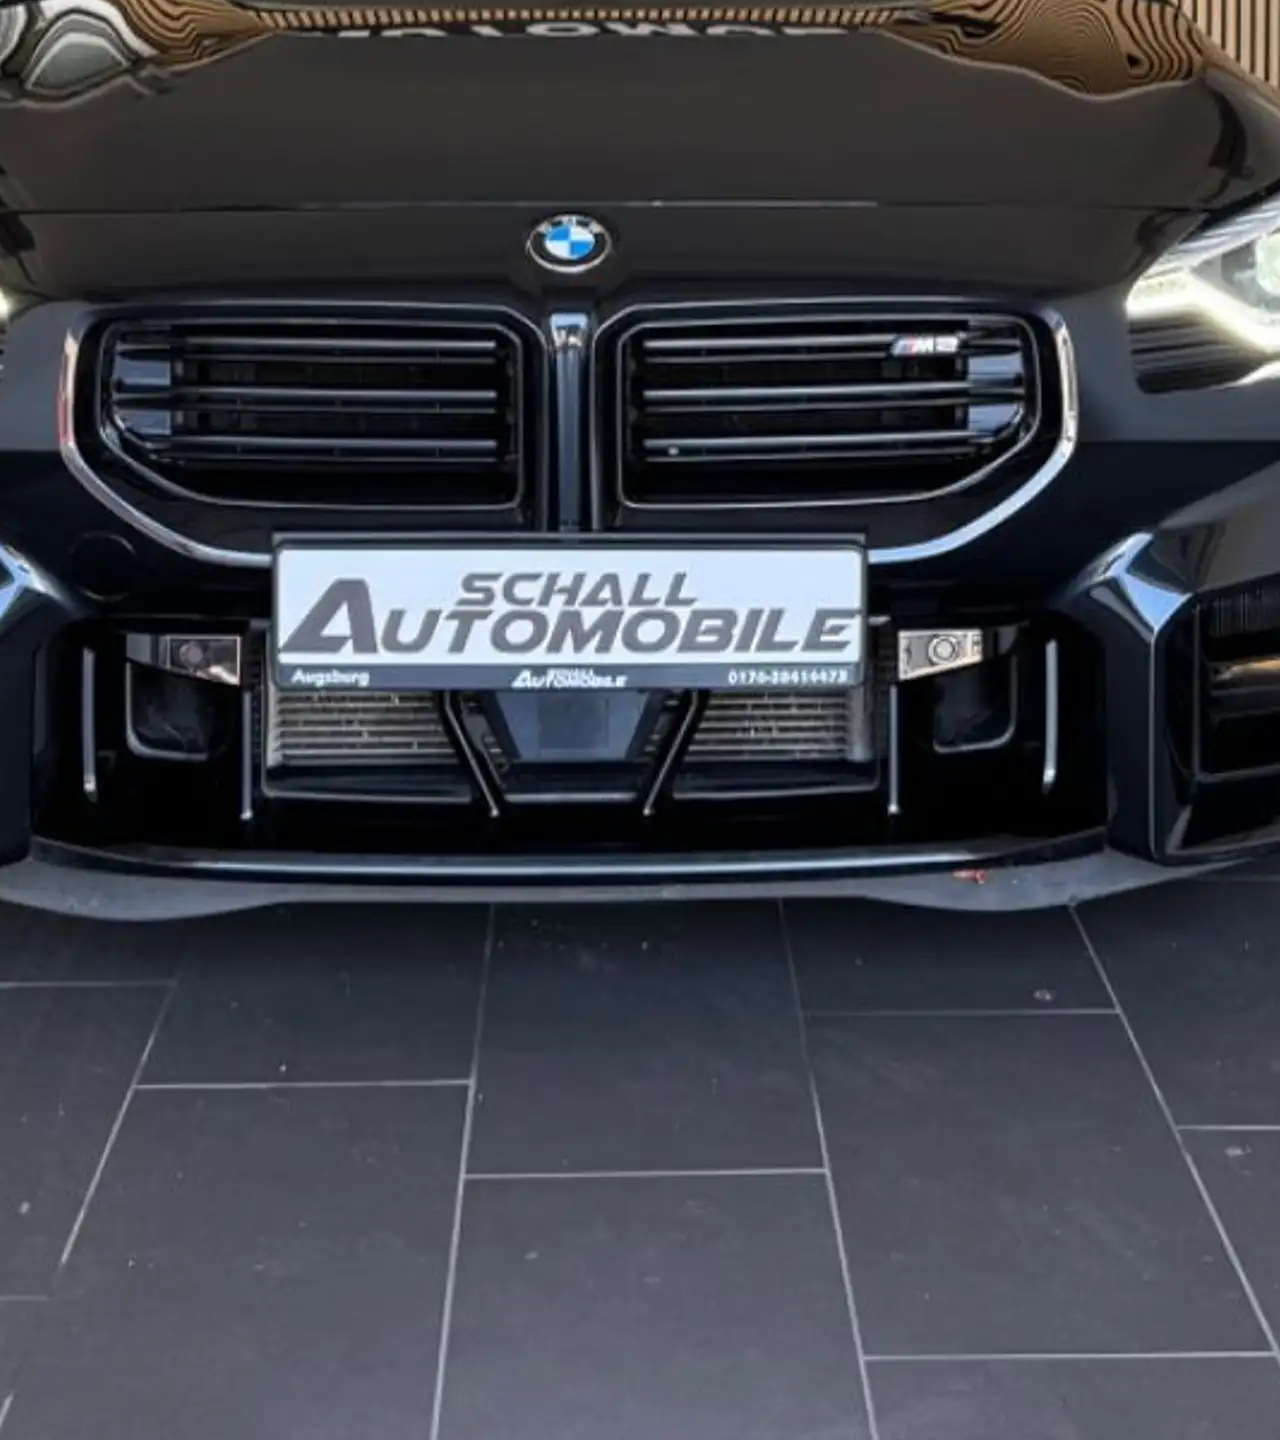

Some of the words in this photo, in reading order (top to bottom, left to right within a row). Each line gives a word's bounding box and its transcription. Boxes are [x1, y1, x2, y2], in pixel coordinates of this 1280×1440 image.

[456, 572, 698, 607] SCHALL
[279, 578, 861, 653] AUTOMOBILE
[291, 668, 370, 687] Augsburg
